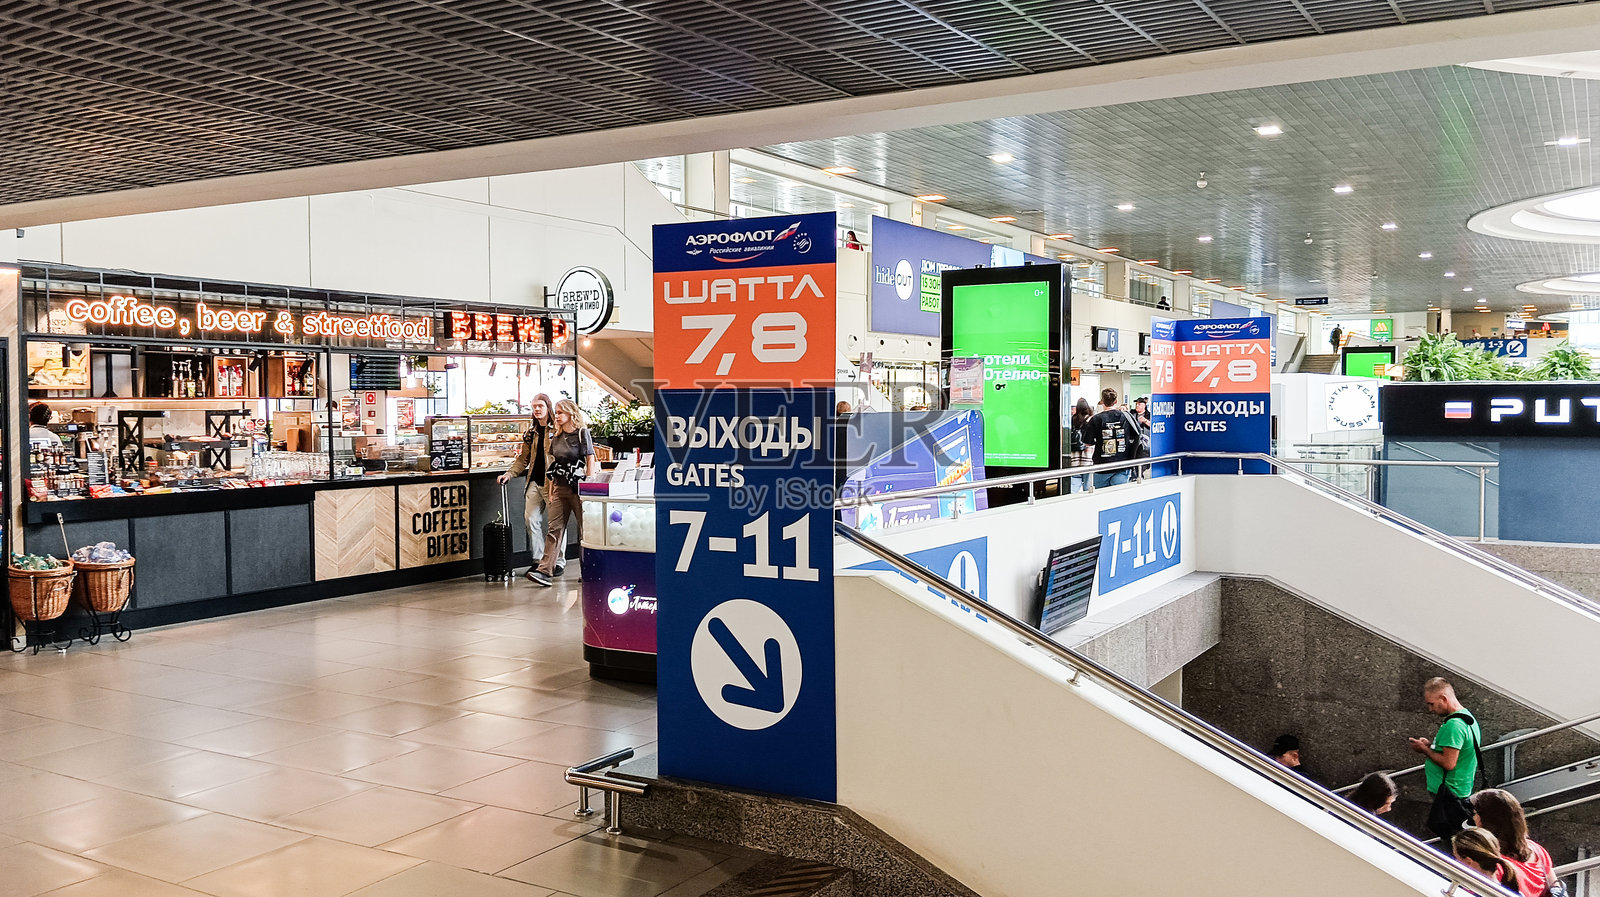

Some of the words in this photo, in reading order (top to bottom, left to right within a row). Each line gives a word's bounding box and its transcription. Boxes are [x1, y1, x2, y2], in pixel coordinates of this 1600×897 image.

[685, 229, 776, 246] АЭРОФЛОТ
[562, 289, 600, 303] BREW'D
[664, 274, 825, 305] ШАТТЛ
[584, 301, 600, 310] ПИВО
[65, 295, 191, 336] coffee,
[197, 302, 266, 332] beer
[274, 311, 295, 335] &
[302, 312, 431, 341] streetfood
[1194, 323, 1242, 331] АЭРОФЛОТ
[1110, 331, 1116, 348] 6
[1181, 343, 1266, 356] ШАТТЛ
[1488, 340, 1503, 348] 1-3
[1190, 359, 1258, 388] 7,8
[1329, 385, 1348, 410] PUTIN
[1357, 384, 1375, 408] TEAM
[1185, 401, 1265, 417] ВЫХОДЫ
[1184, 421, 1227, 432] GATES
[1333, 415, 1373, 428] RUSSIA
[666, 416, 822, 457] ВЫХОДЫ
[666, 462, 745, 488] GATES
[430, 485, 467, 508] BEER
[412, 508, 467, 535] COFFEE
[427, 532, 468, 558] BITES
[669, 510, 819, 582] 7-11
[1107, 508, 1157, 578] 7-11
